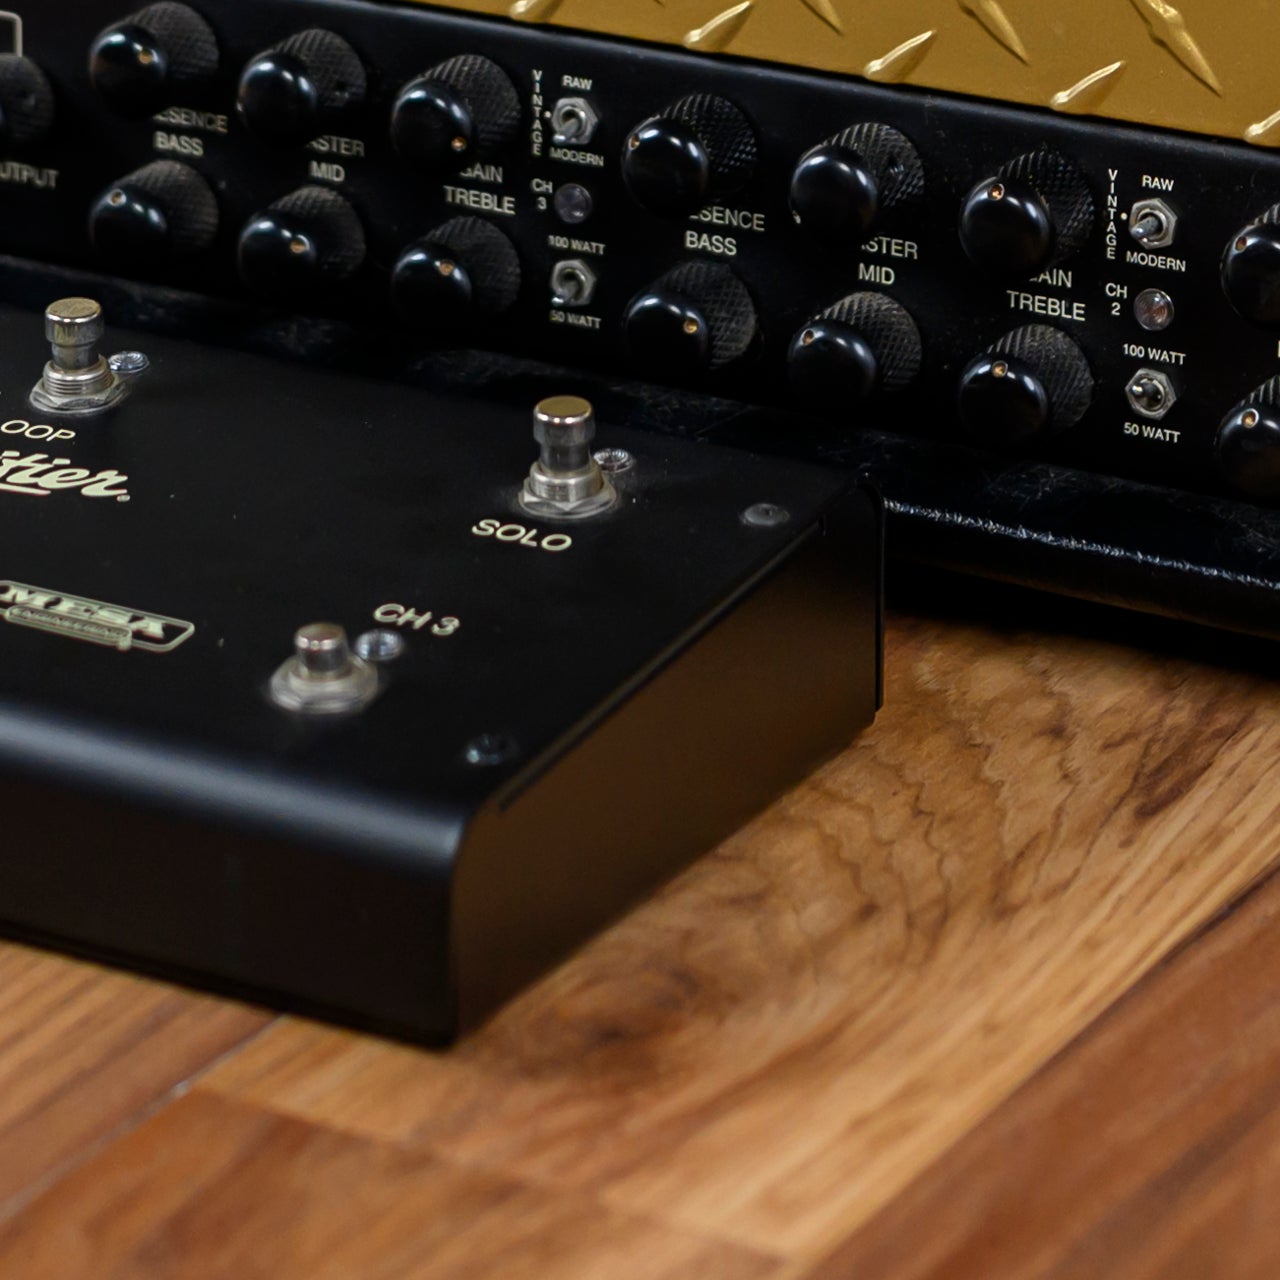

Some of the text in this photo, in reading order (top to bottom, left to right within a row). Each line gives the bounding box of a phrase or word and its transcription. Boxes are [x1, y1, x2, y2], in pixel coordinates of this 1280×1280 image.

[561, 74, 593, 91] RAW
[154, 106, 228, 133] SENCE
[531, 69, 543, 156] VINTAGE
[154, 131, 204, 156] BASS
[306, 134, 366, 158] STER
[550, 147, 604, 167] MODERN
[309, 160, 346, 182] MID
[532, 178, 553, 194] CH
[1142, 175, 1174, 192] RAW
[443, 184, 516, 215] TREBLE
[537, 196, 547, 210] 3
[689, 206, 766, 232] SENCE
[1106, 168, 1118, 260] VINTAGE
[548, 235, 605, 255] 100 WATT
[685, 230, 737, 256] BASS
[861, 236, 919, 260] STER
[1126, 251, 1186, 272] MODERN
[859, 262, 896, 285] MID
[1029, 268, 1073, 289] AIN
[1105, 283, 1128, 299] CH
[1006, 290, 1086, 322] TREBLE
[1111, 302, 1121, 316] 2
[568, 313, 602, 329] WATT
[1123, 343, 1186, 365] 100 WATT
[1124, 423, 1181, 443] 50 WATT
[471, 518, 573, 552] SOLO
[373, 603, 460, 637] CH 3
